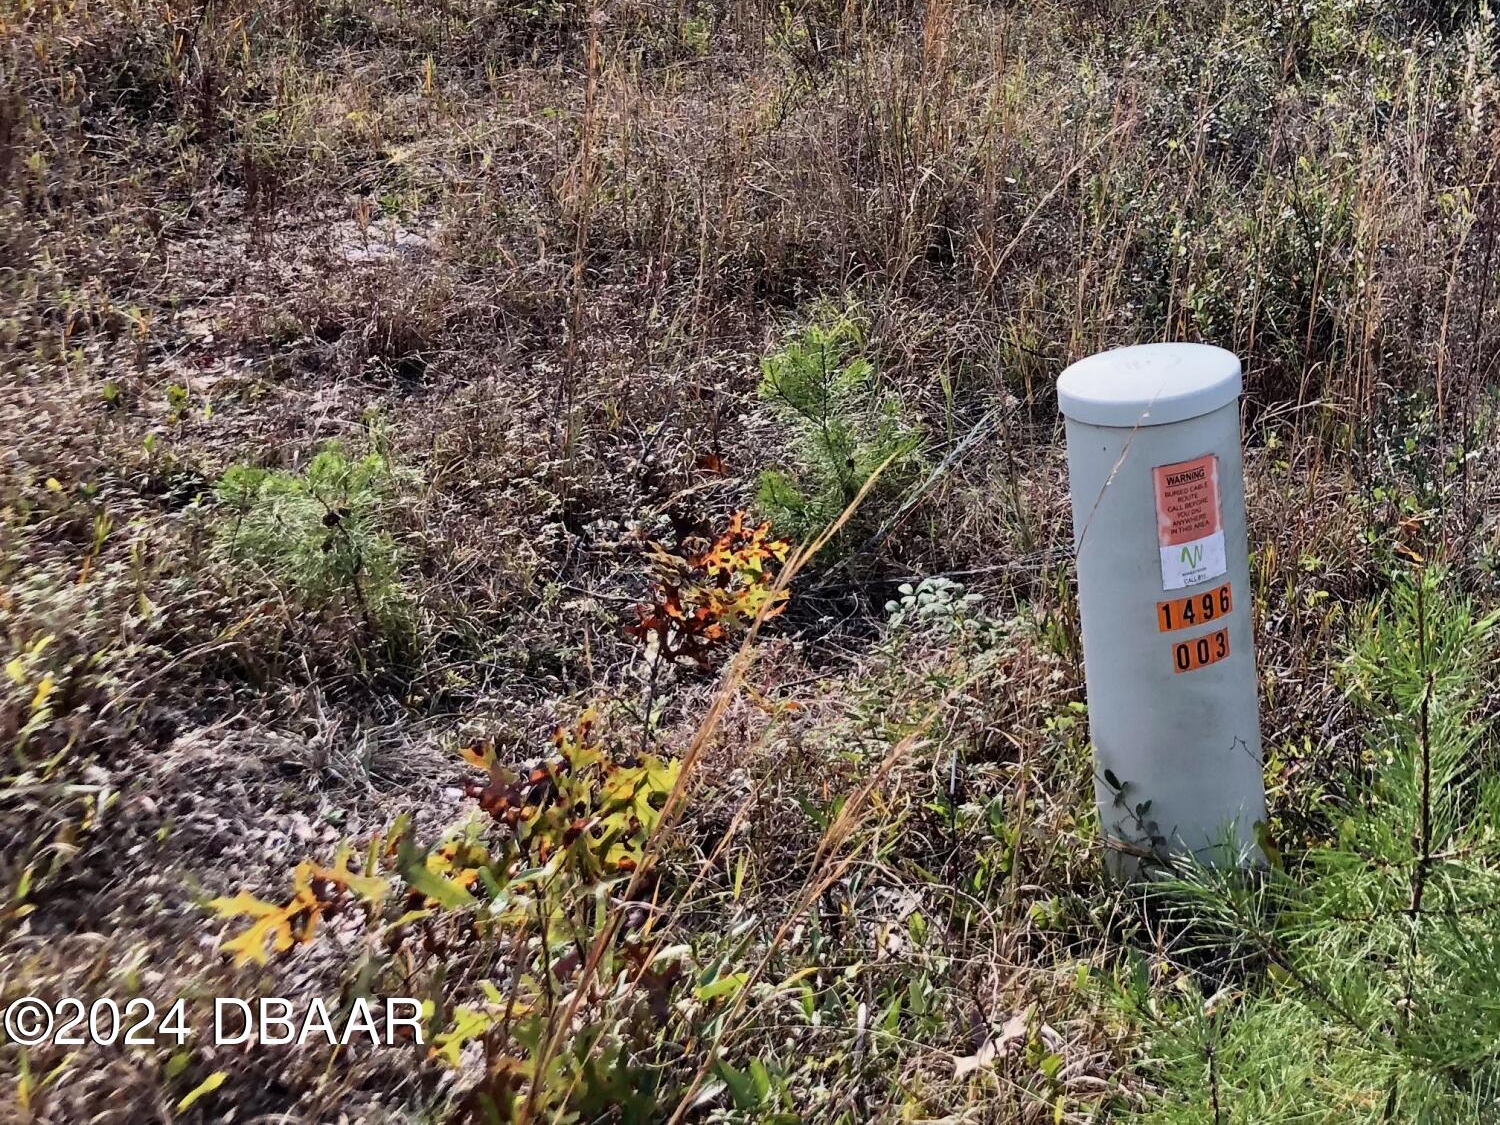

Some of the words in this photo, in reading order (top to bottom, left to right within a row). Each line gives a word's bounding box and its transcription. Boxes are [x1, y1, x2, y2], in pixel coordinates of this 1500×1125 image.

[1166, 469, 1205, 485] WARNING
[1165, 487, 1188, 497] BURIED
[1190, 482, 1208, 493] CABLE
[1167, 504, 1183, 512] CALL
[1184, 497, 1209, 509] BEFORE
[1177, 493, 1199, 502] ROUTE
[1172, 514, 1207, 526] ANYWHERE
[1177, 510, 1190, 518] YOU
[1191, 507, 1202, 515] DIG
[1178, 524, 1192, 533] THIS
[1194, 520, 1210, 530] AREA
[1162, 587, 1229, 629] 1496
[1176, 632, 1226, 669] 003
